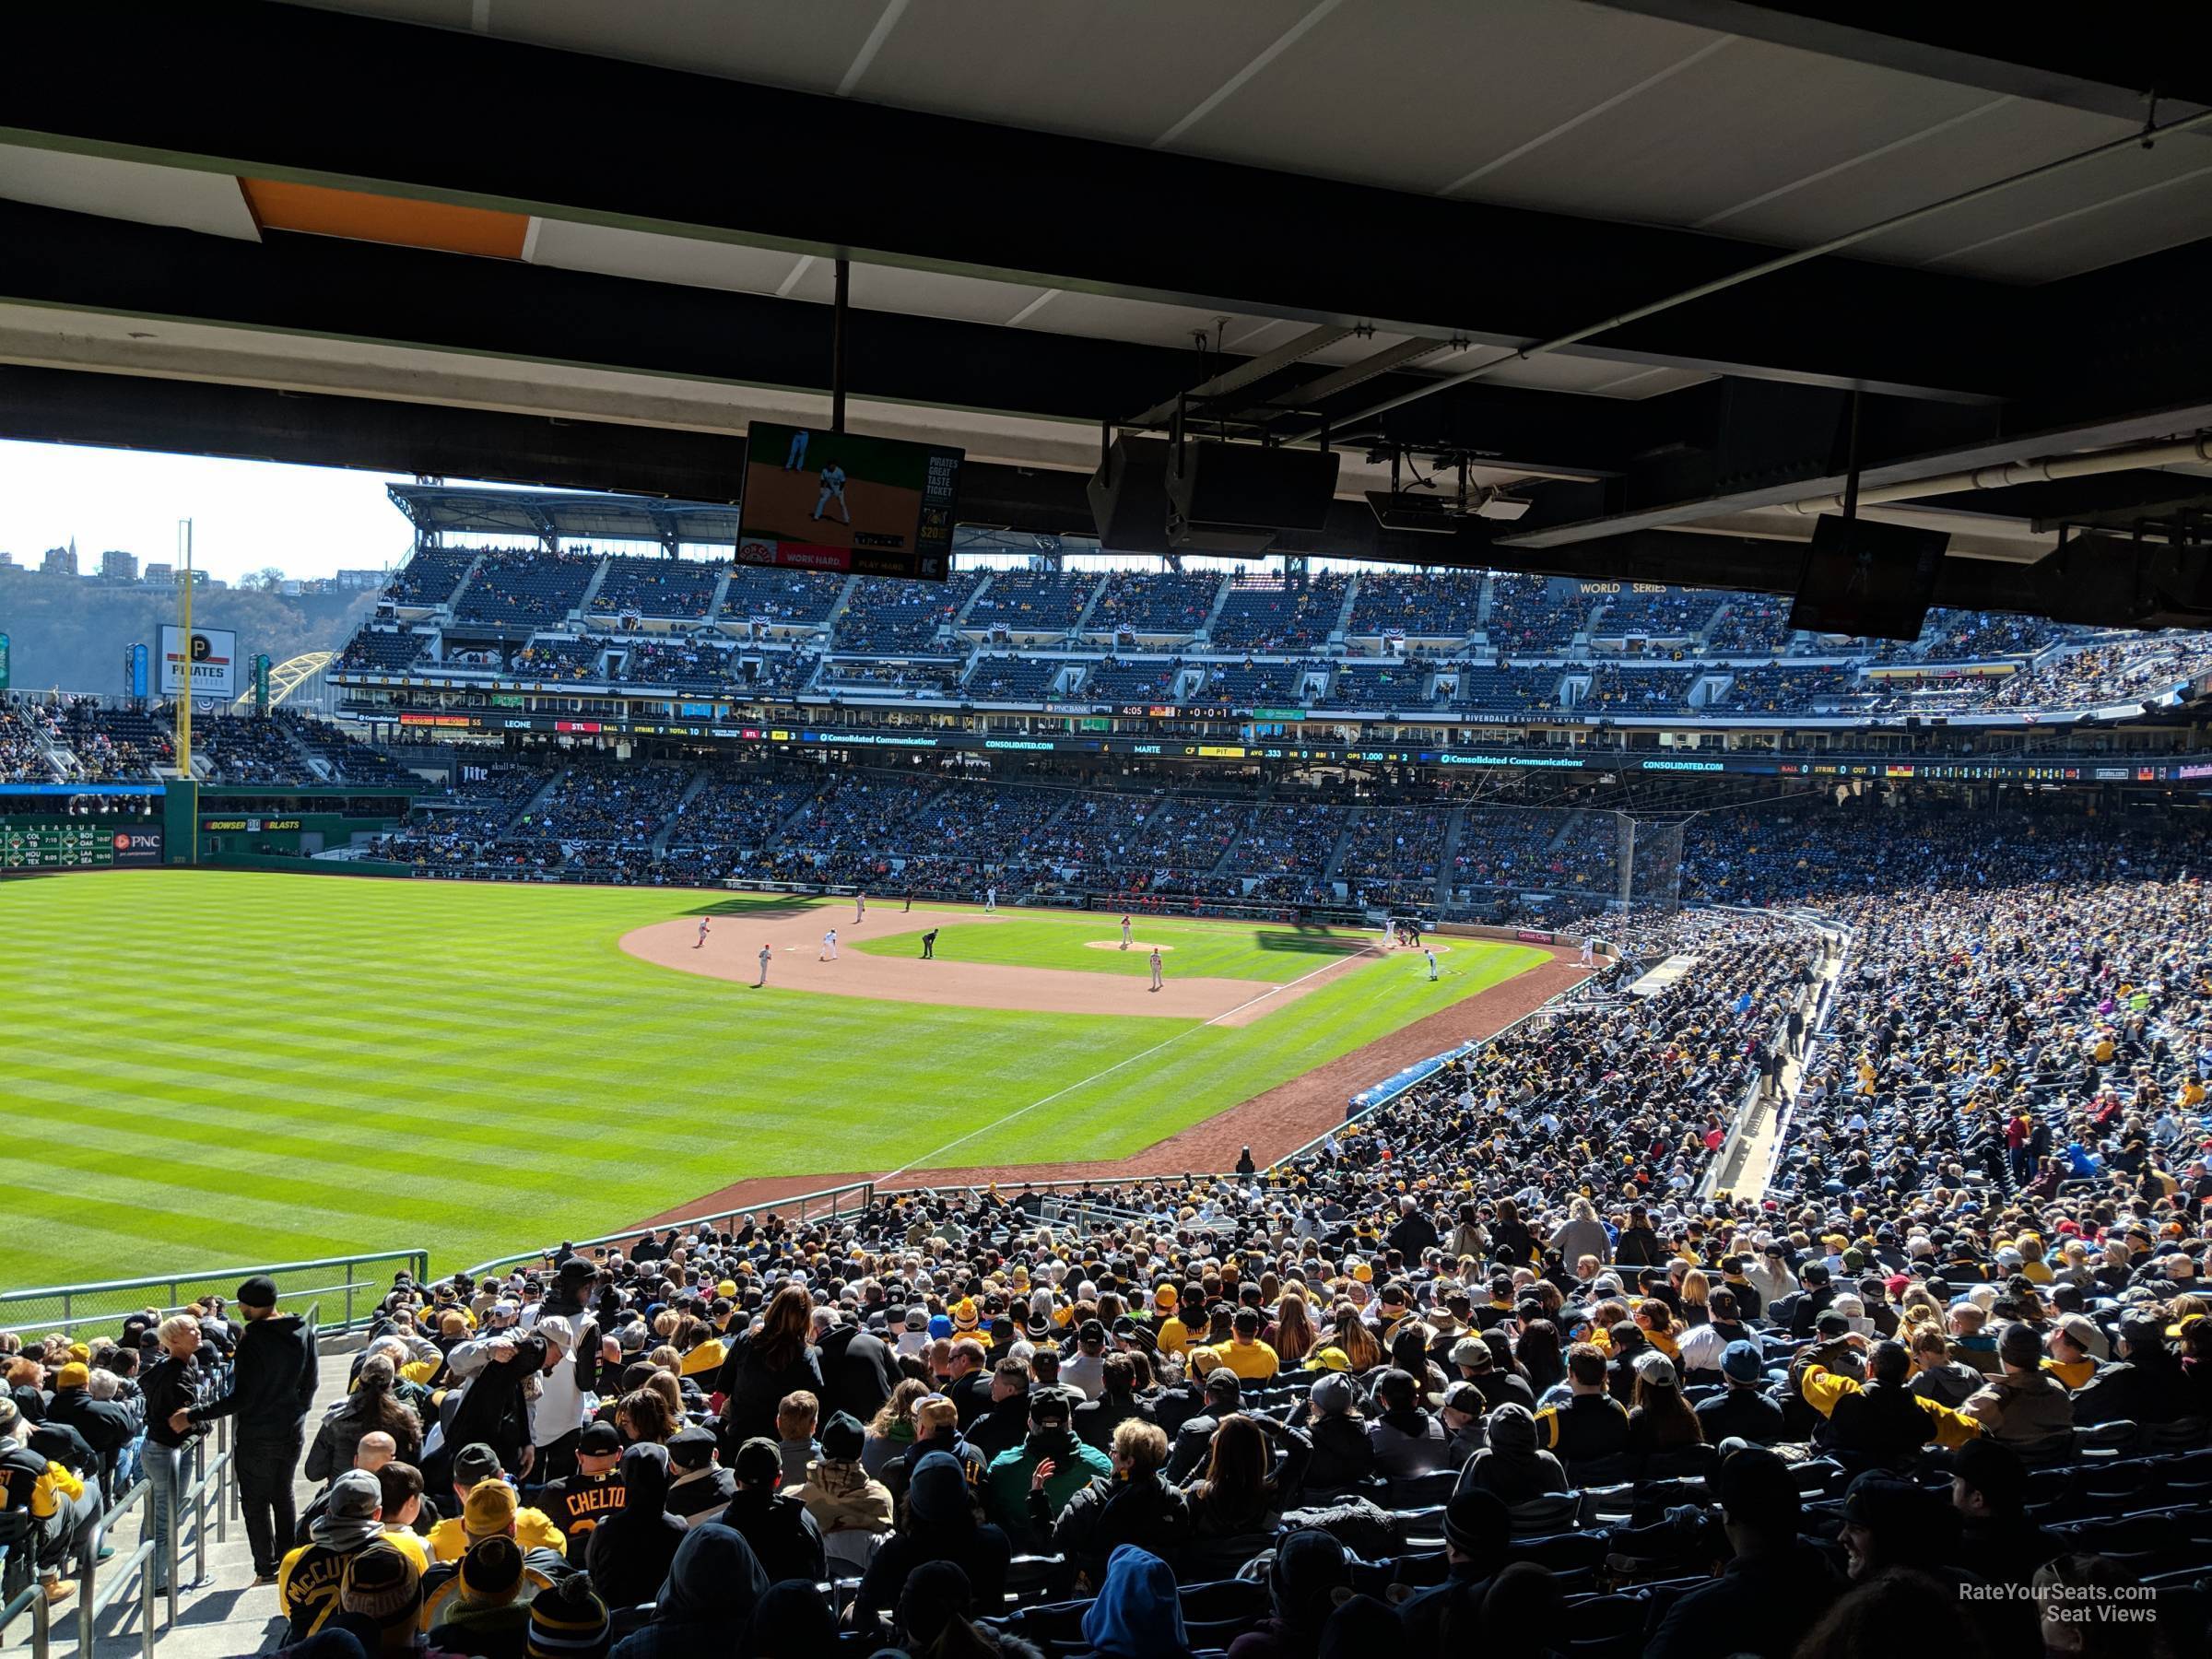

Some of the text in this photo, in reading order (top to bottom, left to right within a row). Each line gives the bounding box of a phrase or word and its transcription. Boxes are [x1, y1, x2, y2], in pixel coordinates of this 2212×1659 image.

[929, 456, 959, 468] PIRATES
[928, 466, 951, 477] GREAT
[927, 476, 950, 487] TASTE
[926, 486, 953, 497] TICKET
[786, 553, 814, 563] WORK
[1580, 582, 1666, 594] WORLD SERIES
[194, 640, 206, 657] P
[171, 665, 225, 678] PIATES
[1123, 707, 1142, 715] 4:05
[1465, 714, 1510, 723] RIVENDALE
[504, 721, 532, 729] LEONE
[571, 723, 585, 731] STL
[658, 726, 665, 735] 9
[689, 727, 700, 735] 10
[829, 734, 936, 746] Consolidated Communications
[985, 740, 1054, 750] CONSOLIDATED.COM
[1135, 746, 1161, 754] MARTE
[1185, 747, 1196, 755] CF
[1265, 749, 1282, 758] .333
[1362, 752, 1383, 761] 1.000
[1402, 753, 1408, 761] 2
[1451, 755, 1584, 767] Consolidated Communications
[1643, 760, 1724, 771] CONSOLIDATED.COM
[1853, 766, 1867, 774] OUT
[210, 821, 246, 830] BOWSER
[269, 821, 300, 830] BLASTS
[131, 835, 160, 848] PNC
[1518, 931, 1535, 939] Great
